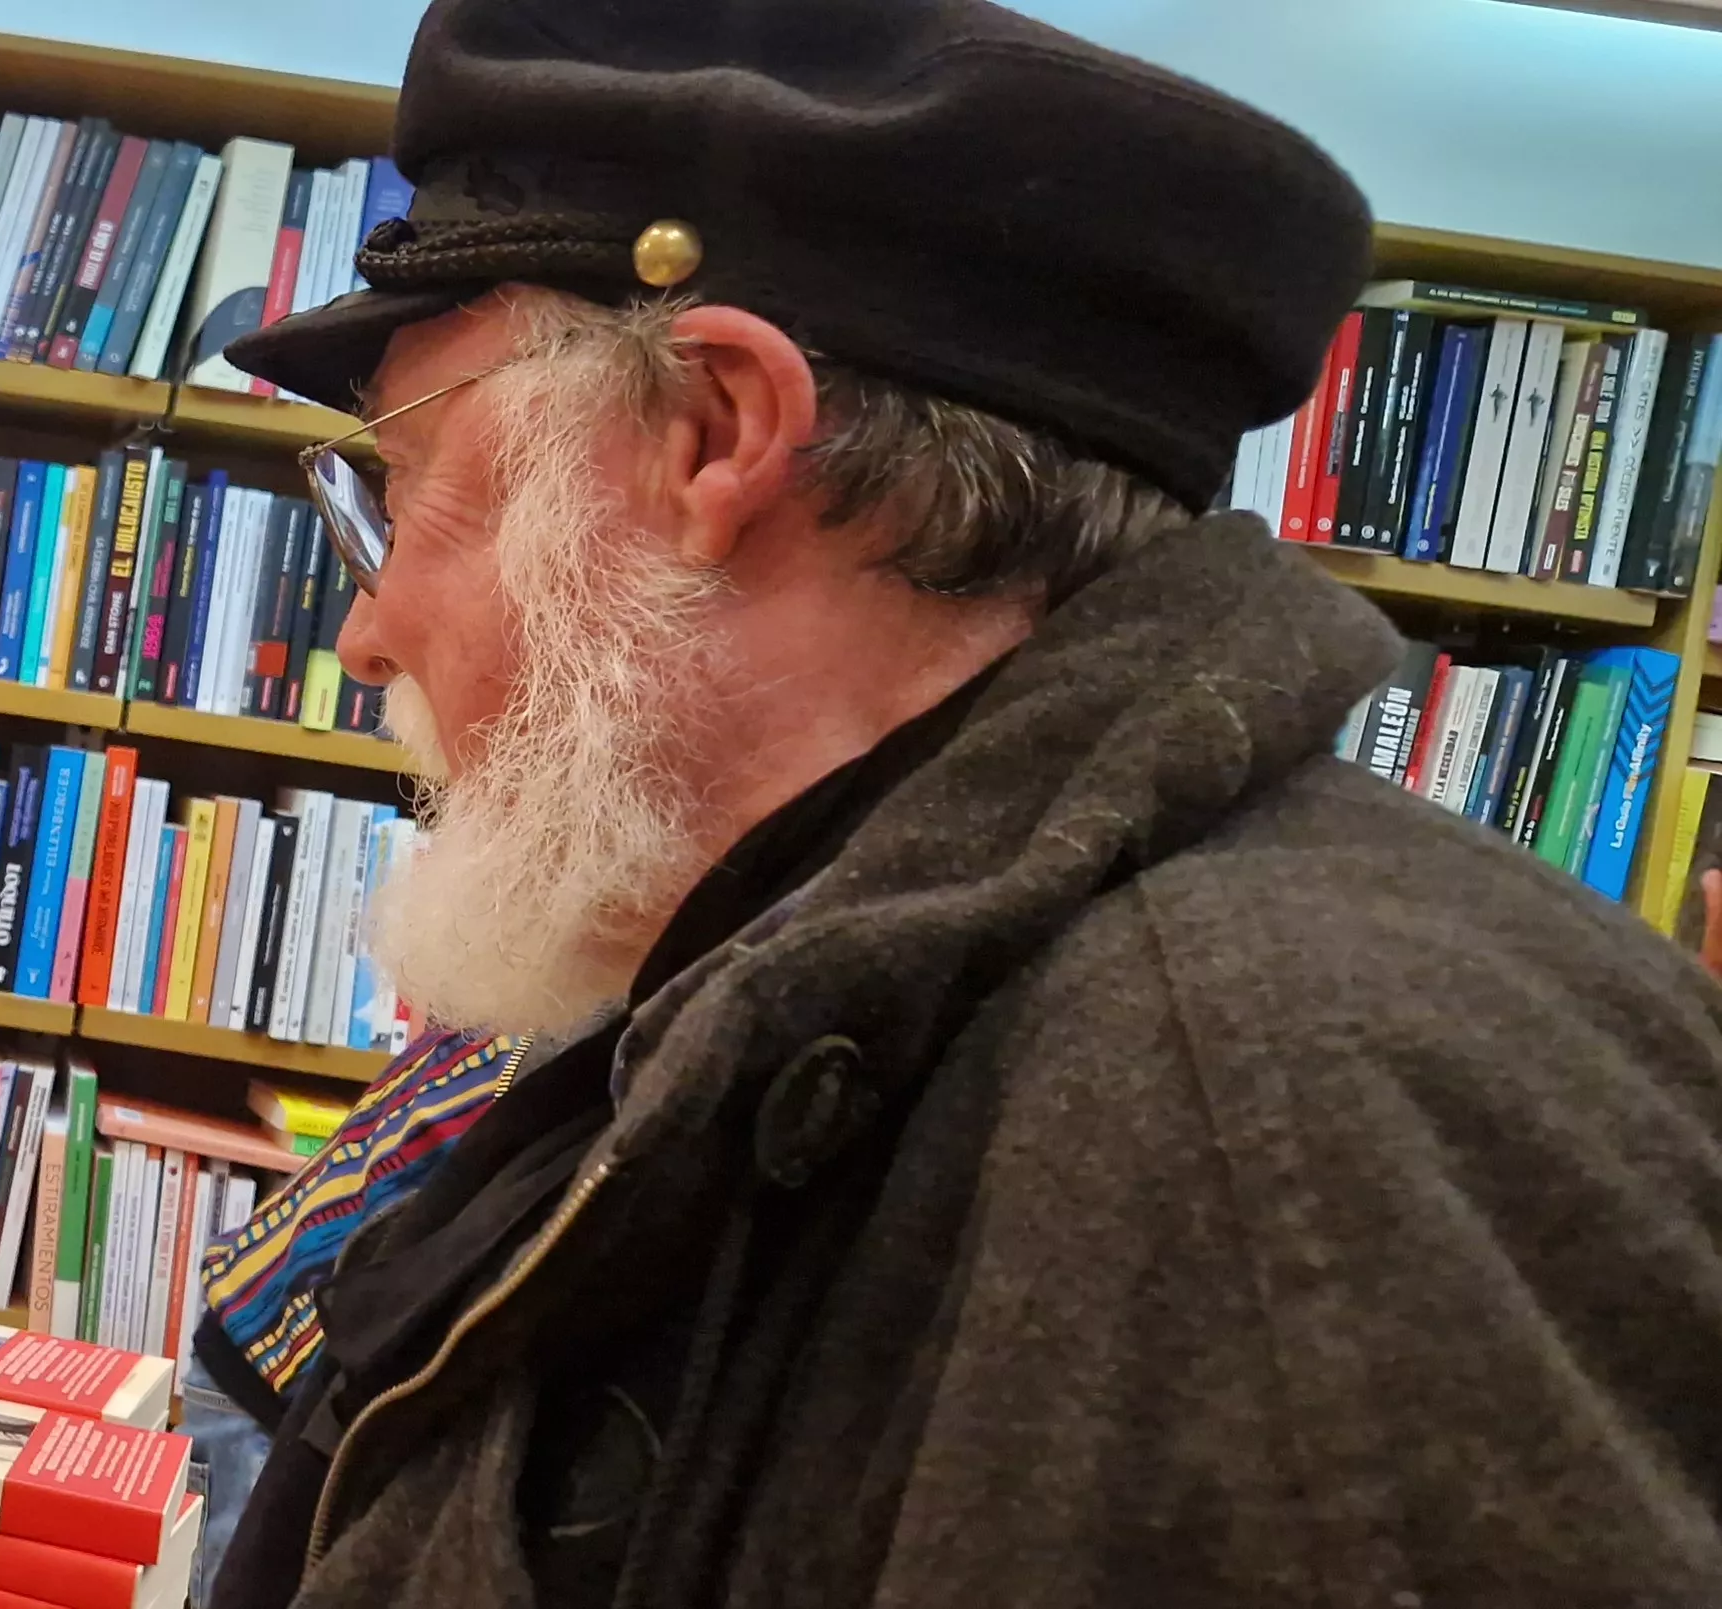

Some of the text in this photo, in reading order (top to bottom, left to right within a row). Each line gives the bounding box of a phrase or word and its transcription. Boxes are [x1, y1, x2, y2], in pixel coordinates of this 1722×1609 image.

[111, 457, 145, 579] EL HOLOCAUSTO
[1605, 508, 1624, 557] FUENTE
[104, 590, 123, 654] DAN STONE
[1367, 683, 1412, 780] AMALEÓN
[34, 1162, 61, 1313] ESTIRAMIENTOS
